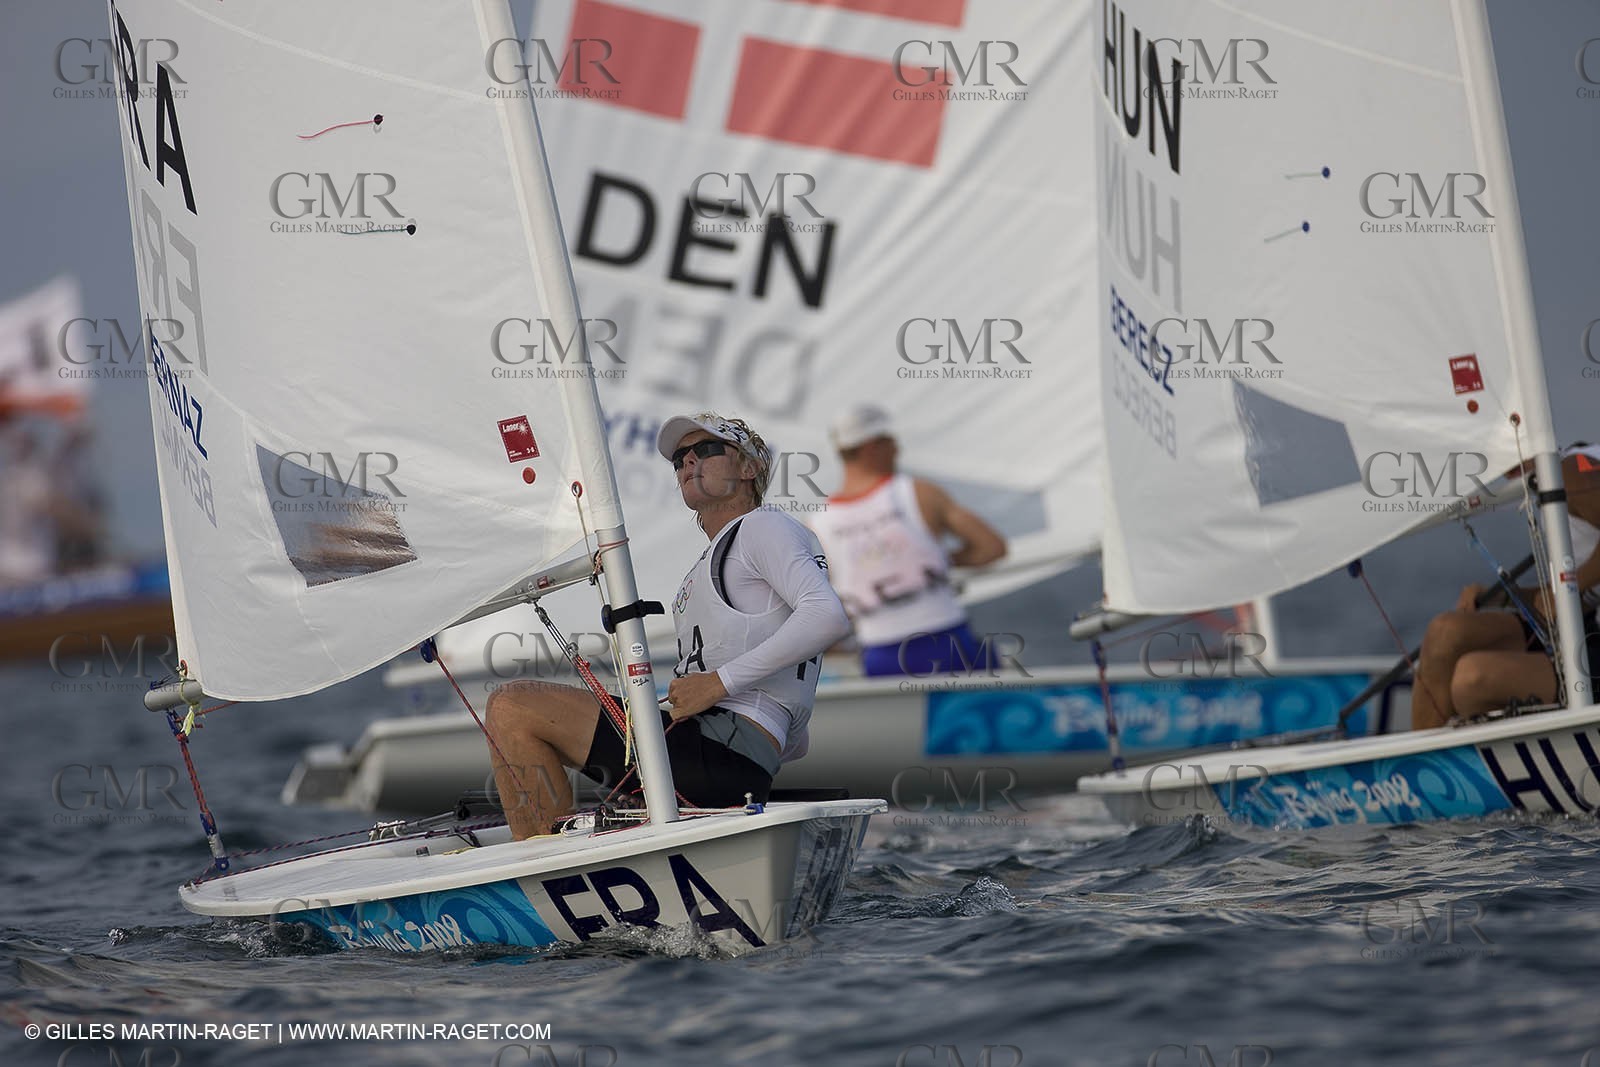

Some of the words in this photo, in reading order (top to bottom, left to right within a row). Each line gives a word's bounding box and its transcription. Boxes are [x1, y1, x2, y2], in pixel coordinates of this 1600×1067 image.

[1103, 0, 1181, 175] HUN
[574, 168, 839, 310] DEN
[1110, 284, 1175, 396] BERECZ
[1353, 773, 1421, 812] 2008
[1481, 729, 1600, 814] HU
[541, 854, 767, 948] FRA
